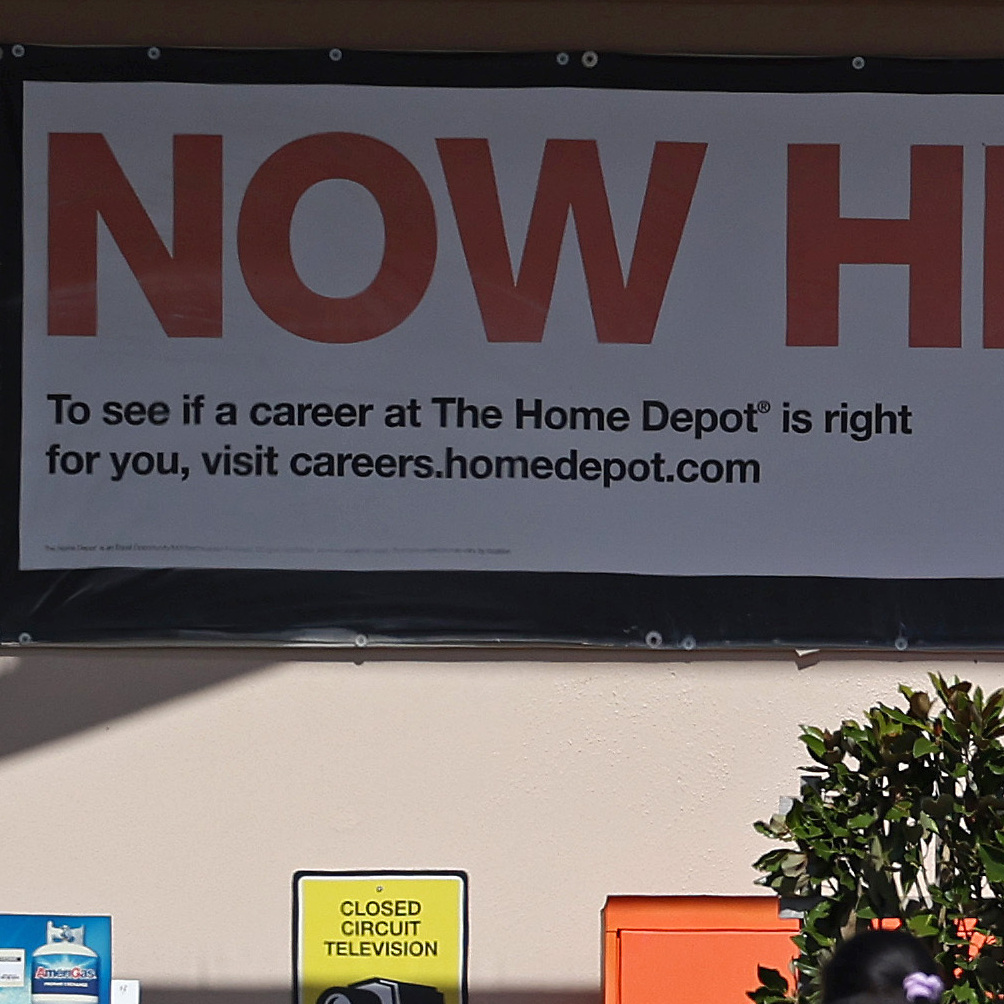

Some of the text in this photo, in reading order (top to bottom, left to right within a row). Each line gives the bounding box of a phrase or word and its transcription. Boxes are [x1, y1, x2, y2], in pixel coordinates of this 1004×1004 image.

[48, 132, 707, 344] NOW
[47, 394, 91, 425] To
[102, 402, 170, 426] see
[182, 394, 205, 425] if
[215, 402, 237, 426] a
[249, 402, 374, 427] career
[384, 398, 422, 428] at
[432, 397, 503, 429] The
[515, 399, 631, 431] Home
[783, 402, 813, 433] is
[824, 403, 913, 442] right
[46, 444, 761, 488] for you, visit careers.homedepot.com
[340, 900, 422, 917] CLOSED
[341, 920, 422, 937] CIRCUIT
[324, 940, 438, 957] TELEVISION
